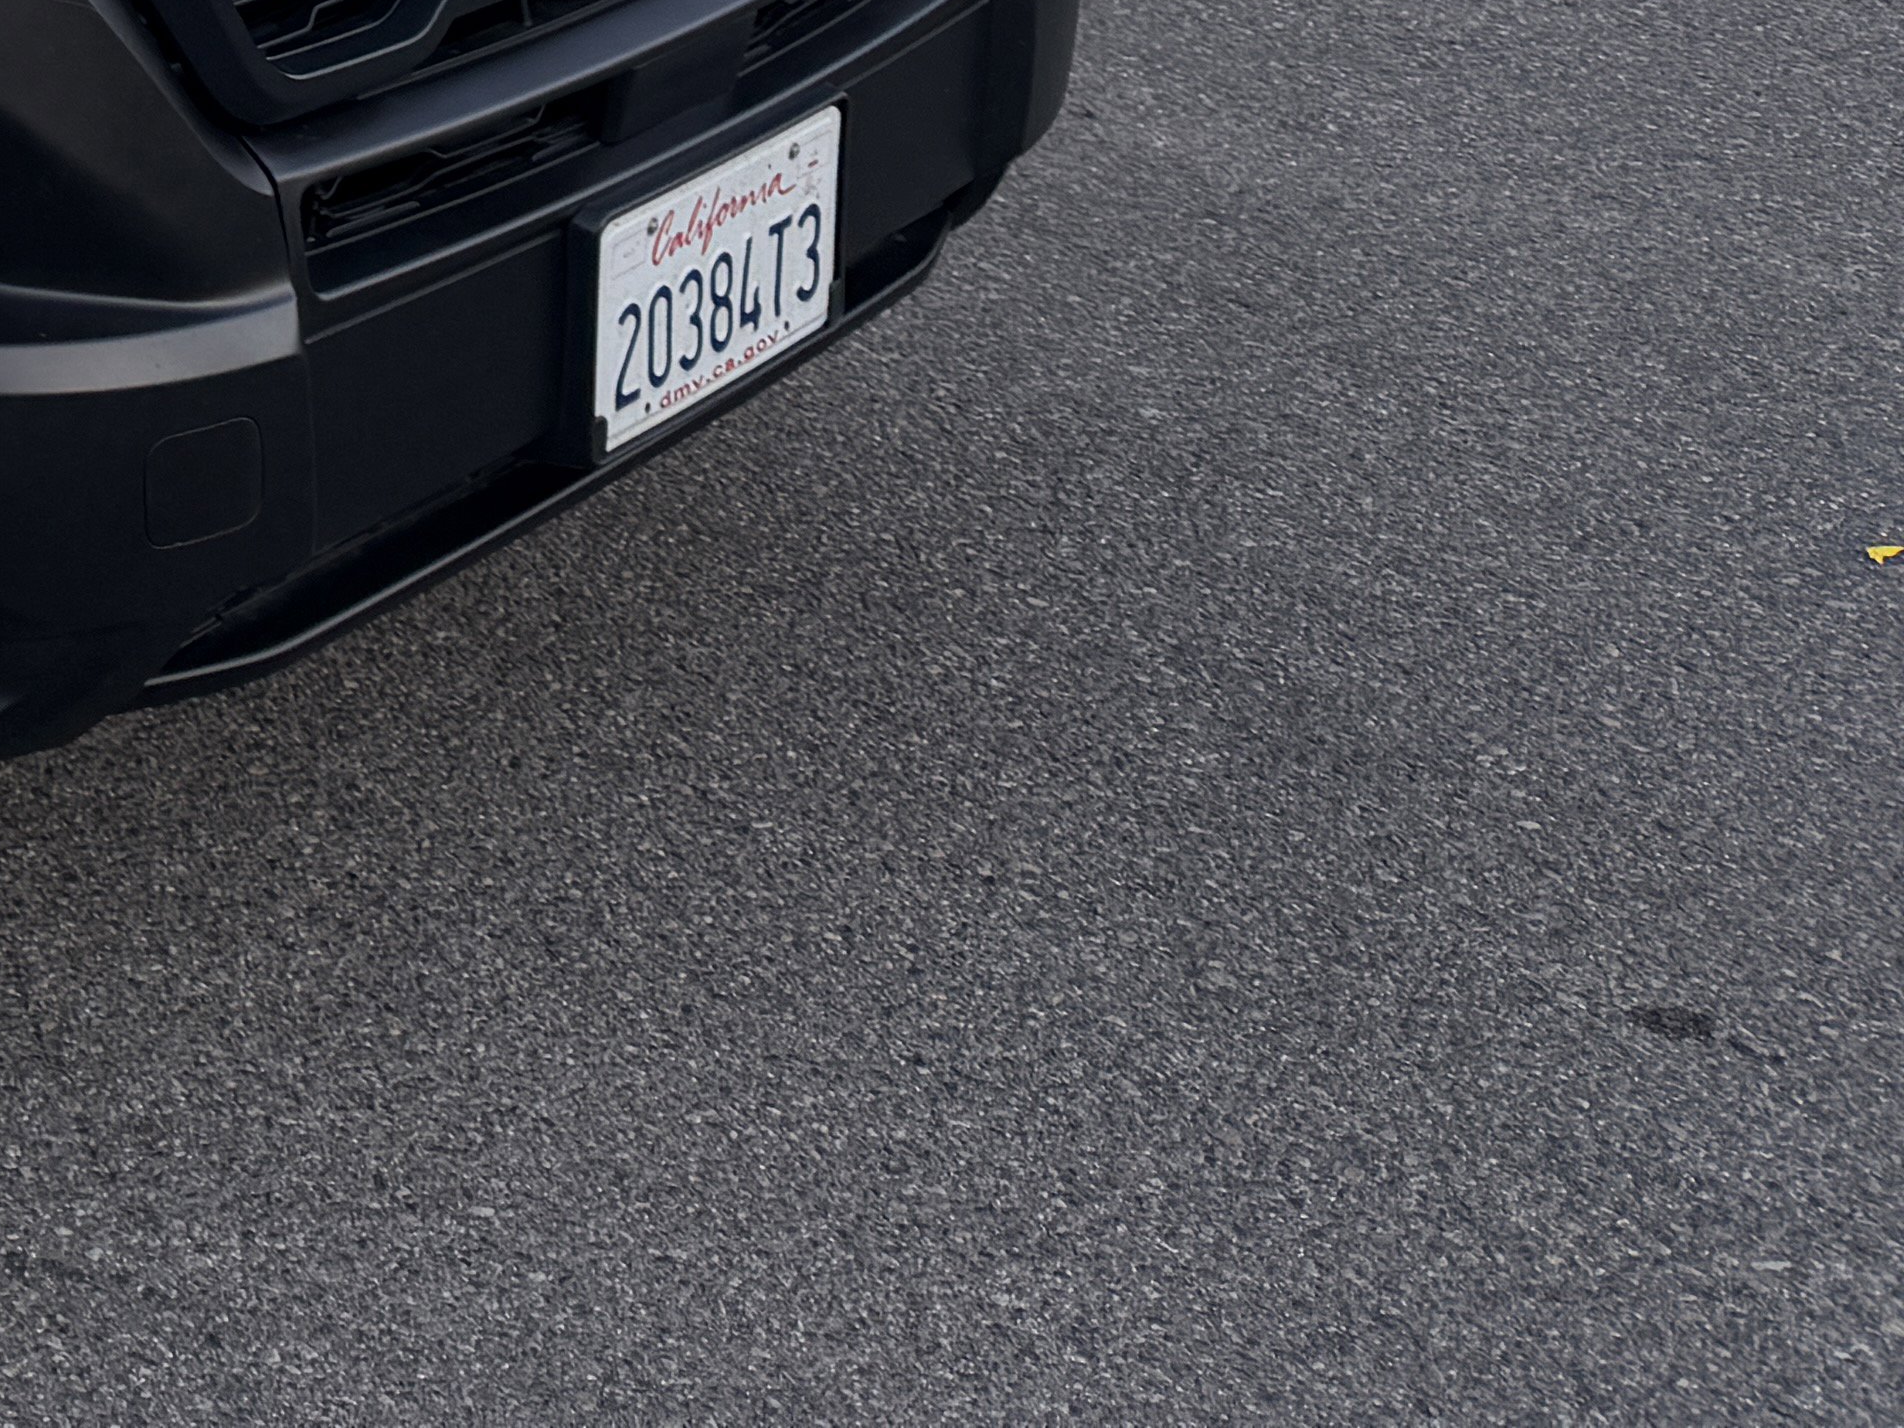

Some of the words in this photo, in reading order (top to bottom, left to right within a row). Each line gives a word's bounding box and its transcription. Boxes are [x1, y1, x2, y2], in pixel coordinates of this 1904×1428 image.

[650, 170, 796, 266] California
[615, 202, 822, 412] 20384T3
[659, 330, 780, 410] dmv.ca.gov
